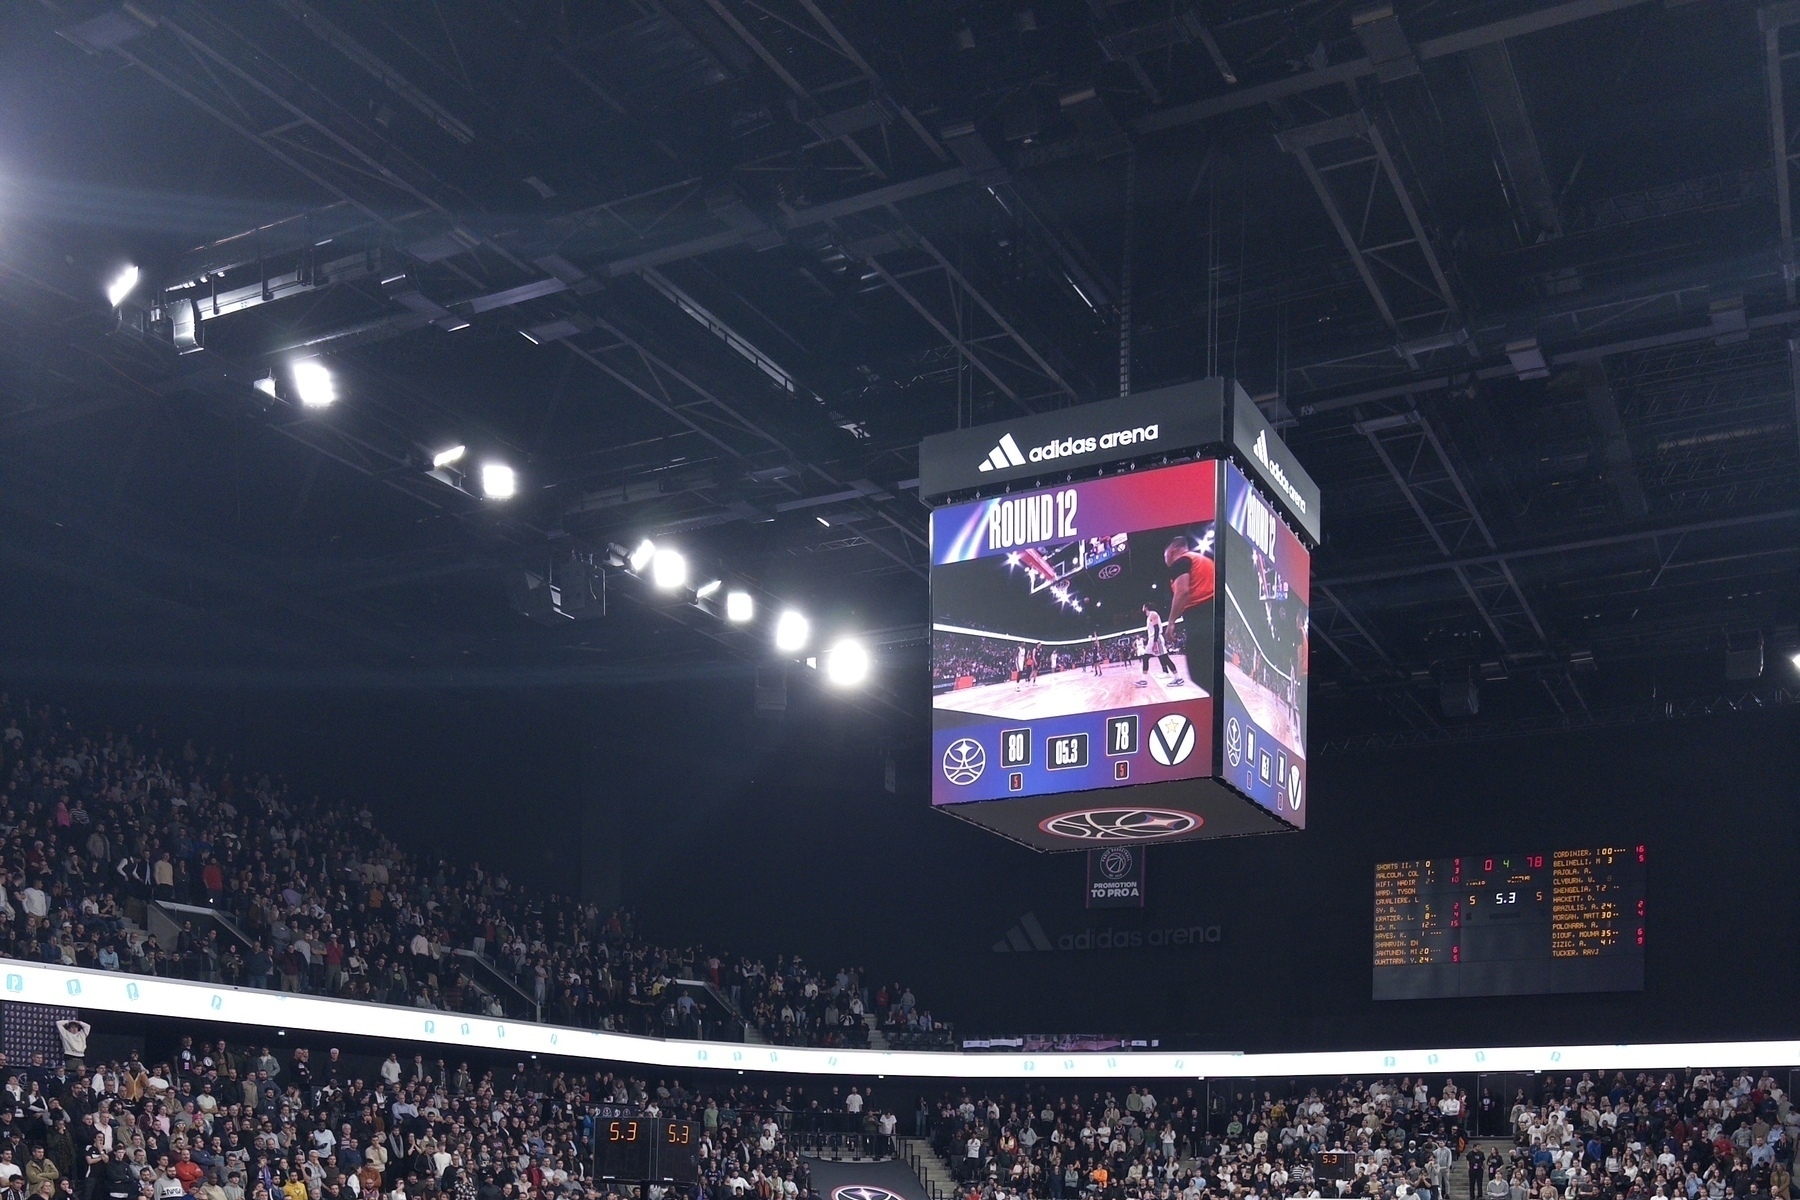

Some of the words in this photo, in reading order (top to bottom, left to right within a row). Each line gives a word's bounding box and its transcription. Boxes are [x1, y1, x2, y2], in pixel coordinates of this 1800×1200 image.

[1029, 437, 1097, 463] adidas
[1099, 424, 1159, 450] arena
[989, 493, 1054, 550] ROUND
[1056, 489, 1078, 538] 12
[1008, 734, 1024, 762] 80
[1056, 738, 1078, 765] 05.3
[1115, 721, 1129, 751] 78
[1601, 848, 1613, 856] 00
[1425, 860, 1431, 868] 0
[1503, 859, 1510, 868] 4
[1527, 856, 1543, 868] 78
[1608, 857, 1613, 865] 3
[1093, 881, 1137, 890] PROMOTION
[1090, 889, 1106, 898] TO
[1107, 888, 1130, 898] PRO
[1130, 887, 1140, 897] A
[1469, 895, 1476, 905] 5
[1496, 892, 1516, 905] 5.3
[1537, 891, 1544, 901] 5
[1601, 912, 1612, 920] 30
[1057, 927, 1143, 951] adidas
[1147, 925, 1221, 946] arena
[1601, 929, 1612, 938] 35
[610, 1122, 637, 1141] 5.3
[669, 1124, 689, 1144] 5.3
[1322, 1155, 1338, 1164] 5.3
